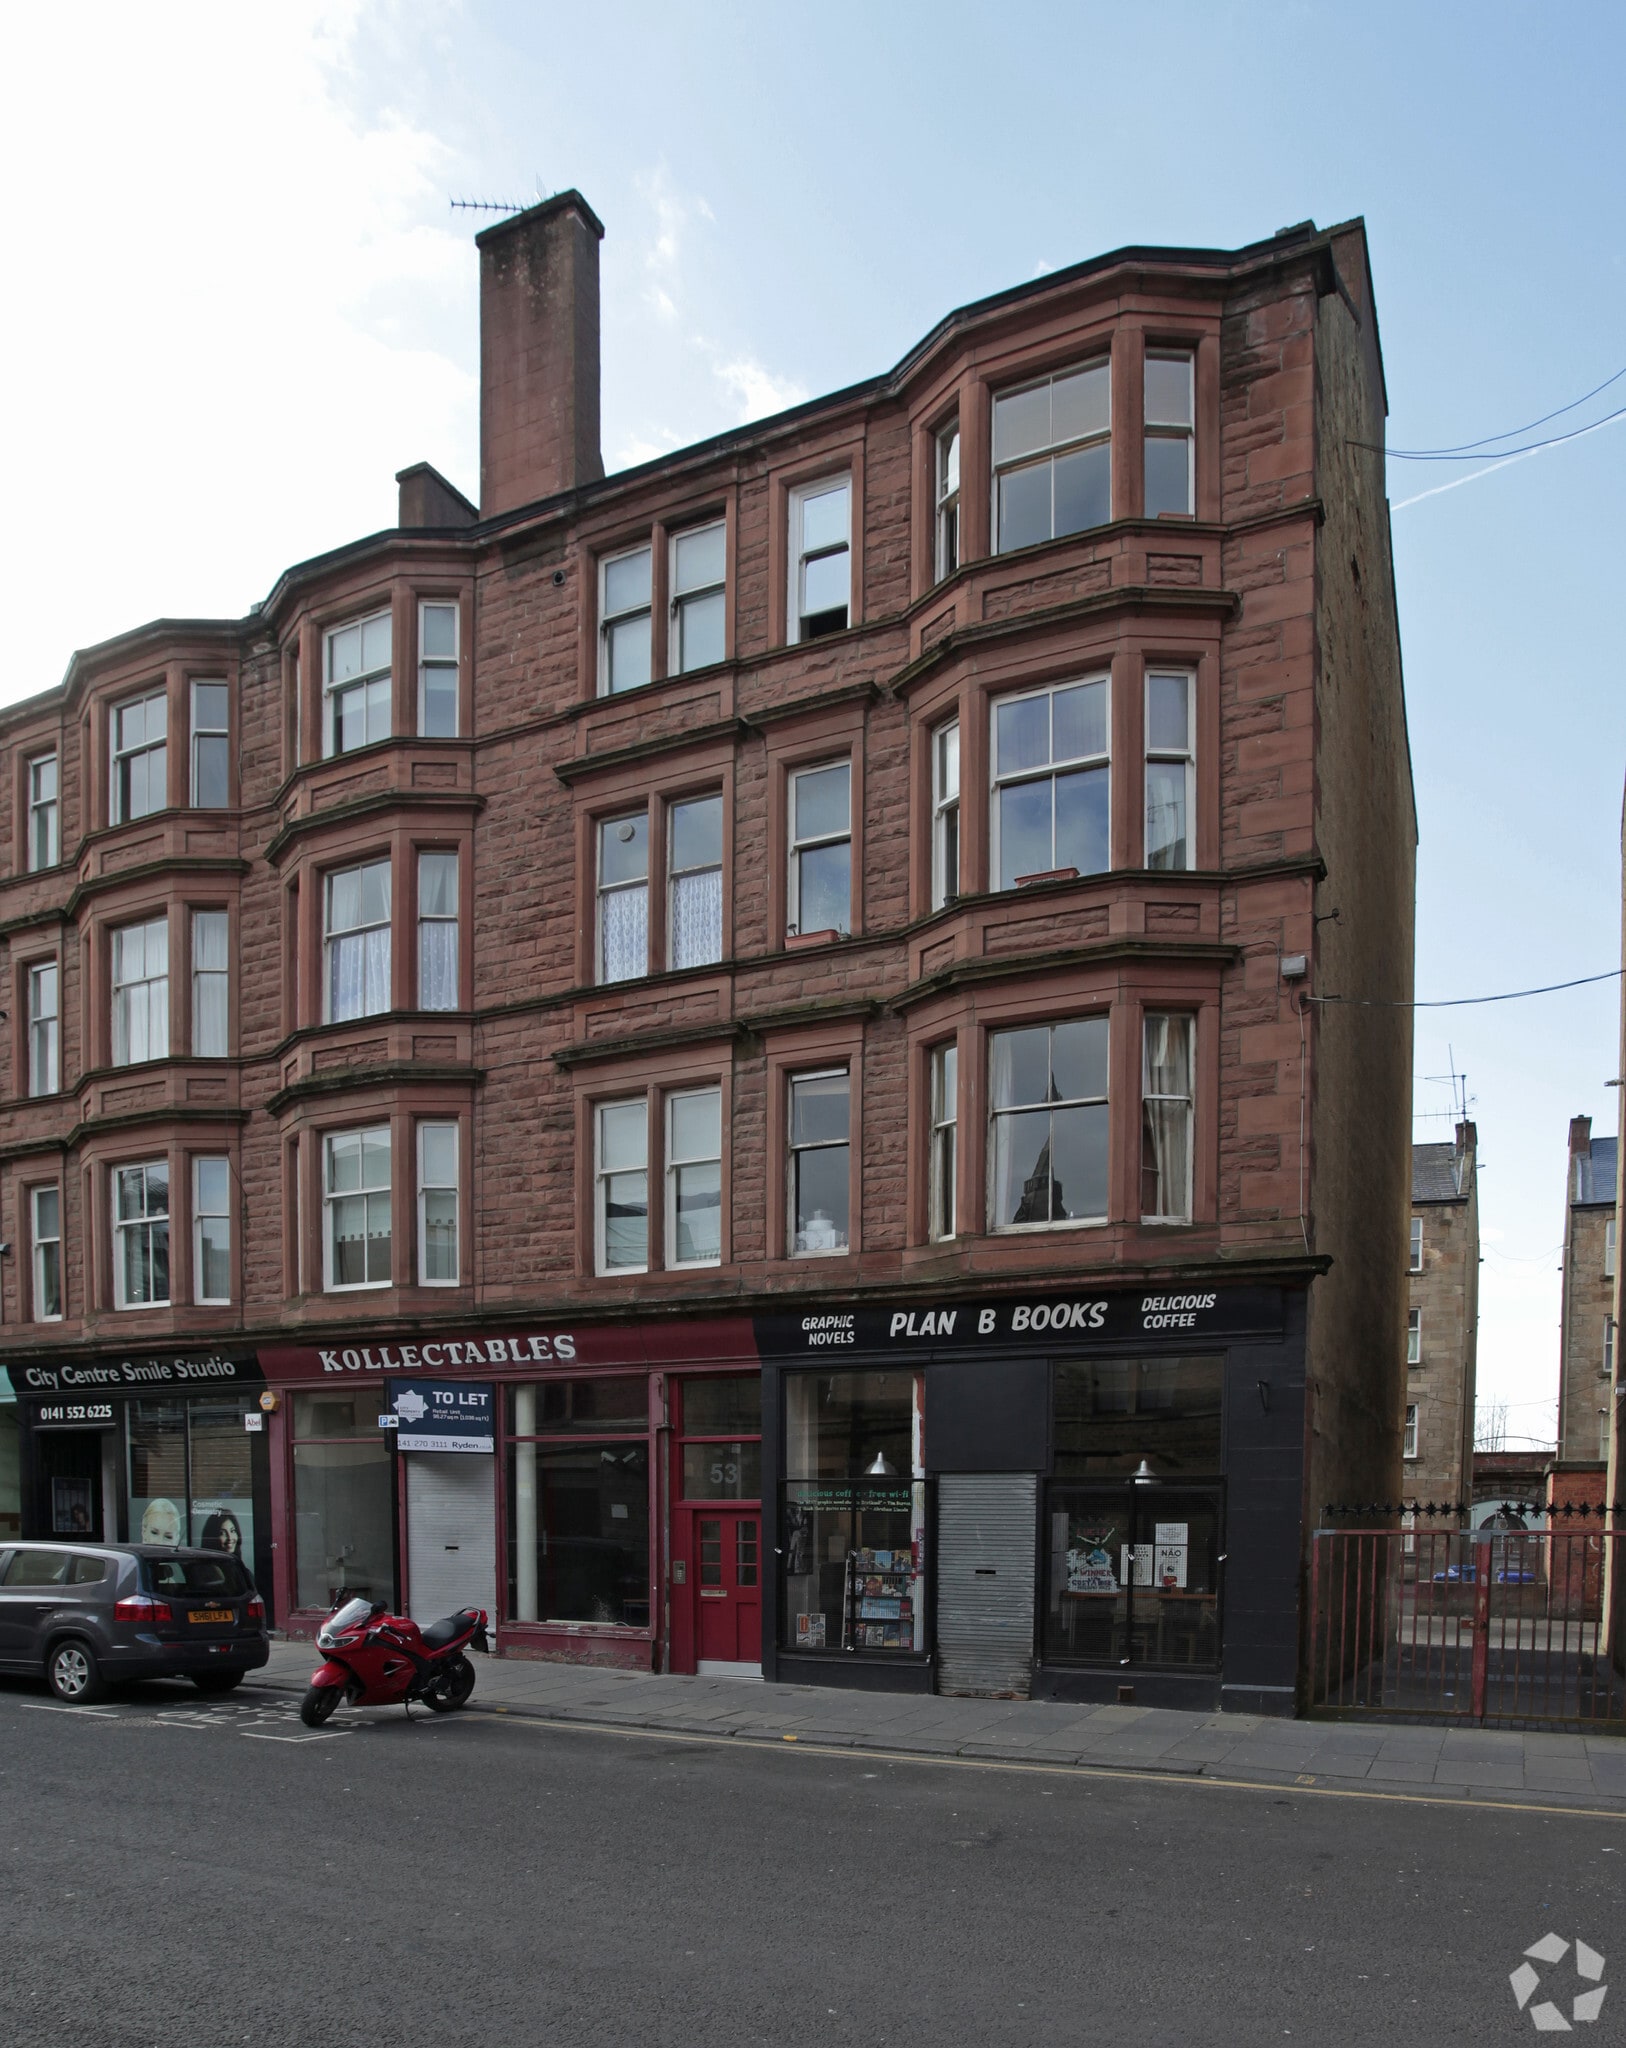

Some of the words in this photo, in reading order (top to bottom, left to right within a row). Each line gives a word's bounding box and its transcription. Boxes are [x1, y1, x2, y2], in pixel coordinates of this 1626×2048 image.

[1141, 1293, 1216, 1312] DELICIOUS
[801, 1315, 855, 1330] GRAPHIC
[889, 1310, 957, 1337] PLAN
[977, 1308, 996, 1334] B
[1011, 1301, 1108, 1331] BOOKS
[1143, 1313, 1197, 1329] COFFEE
[808, 1331, 855, 1345] NOVELS
[318, 1334, 576, 1372] KOLLECTABLES
[25, 1367, 59, 1389] City
[61, 1365, 121, 1385] Centre
[122, 1361, 172, 1381] Smile
[174, 1356, 236, 1379] Studio
[432, 1391, 454, 1404] TO
[458, 1392, 488, 1406] LET
[40, 1406, 64, 1420] 0141
[67, 1406, 85, 1419] 552
[88, 1405, 112, 1418] 6225
[247, 1418, 261, 1427] Abel
[710, 1463, 738, 1484] 53
[869, 1489, 886, 1498] free
[890, 1489, 909, 1498] wi-fi
[192, 1500, 223, 1508] Cosmetic
[1080, 1569, 1112, 1577] WINNER
